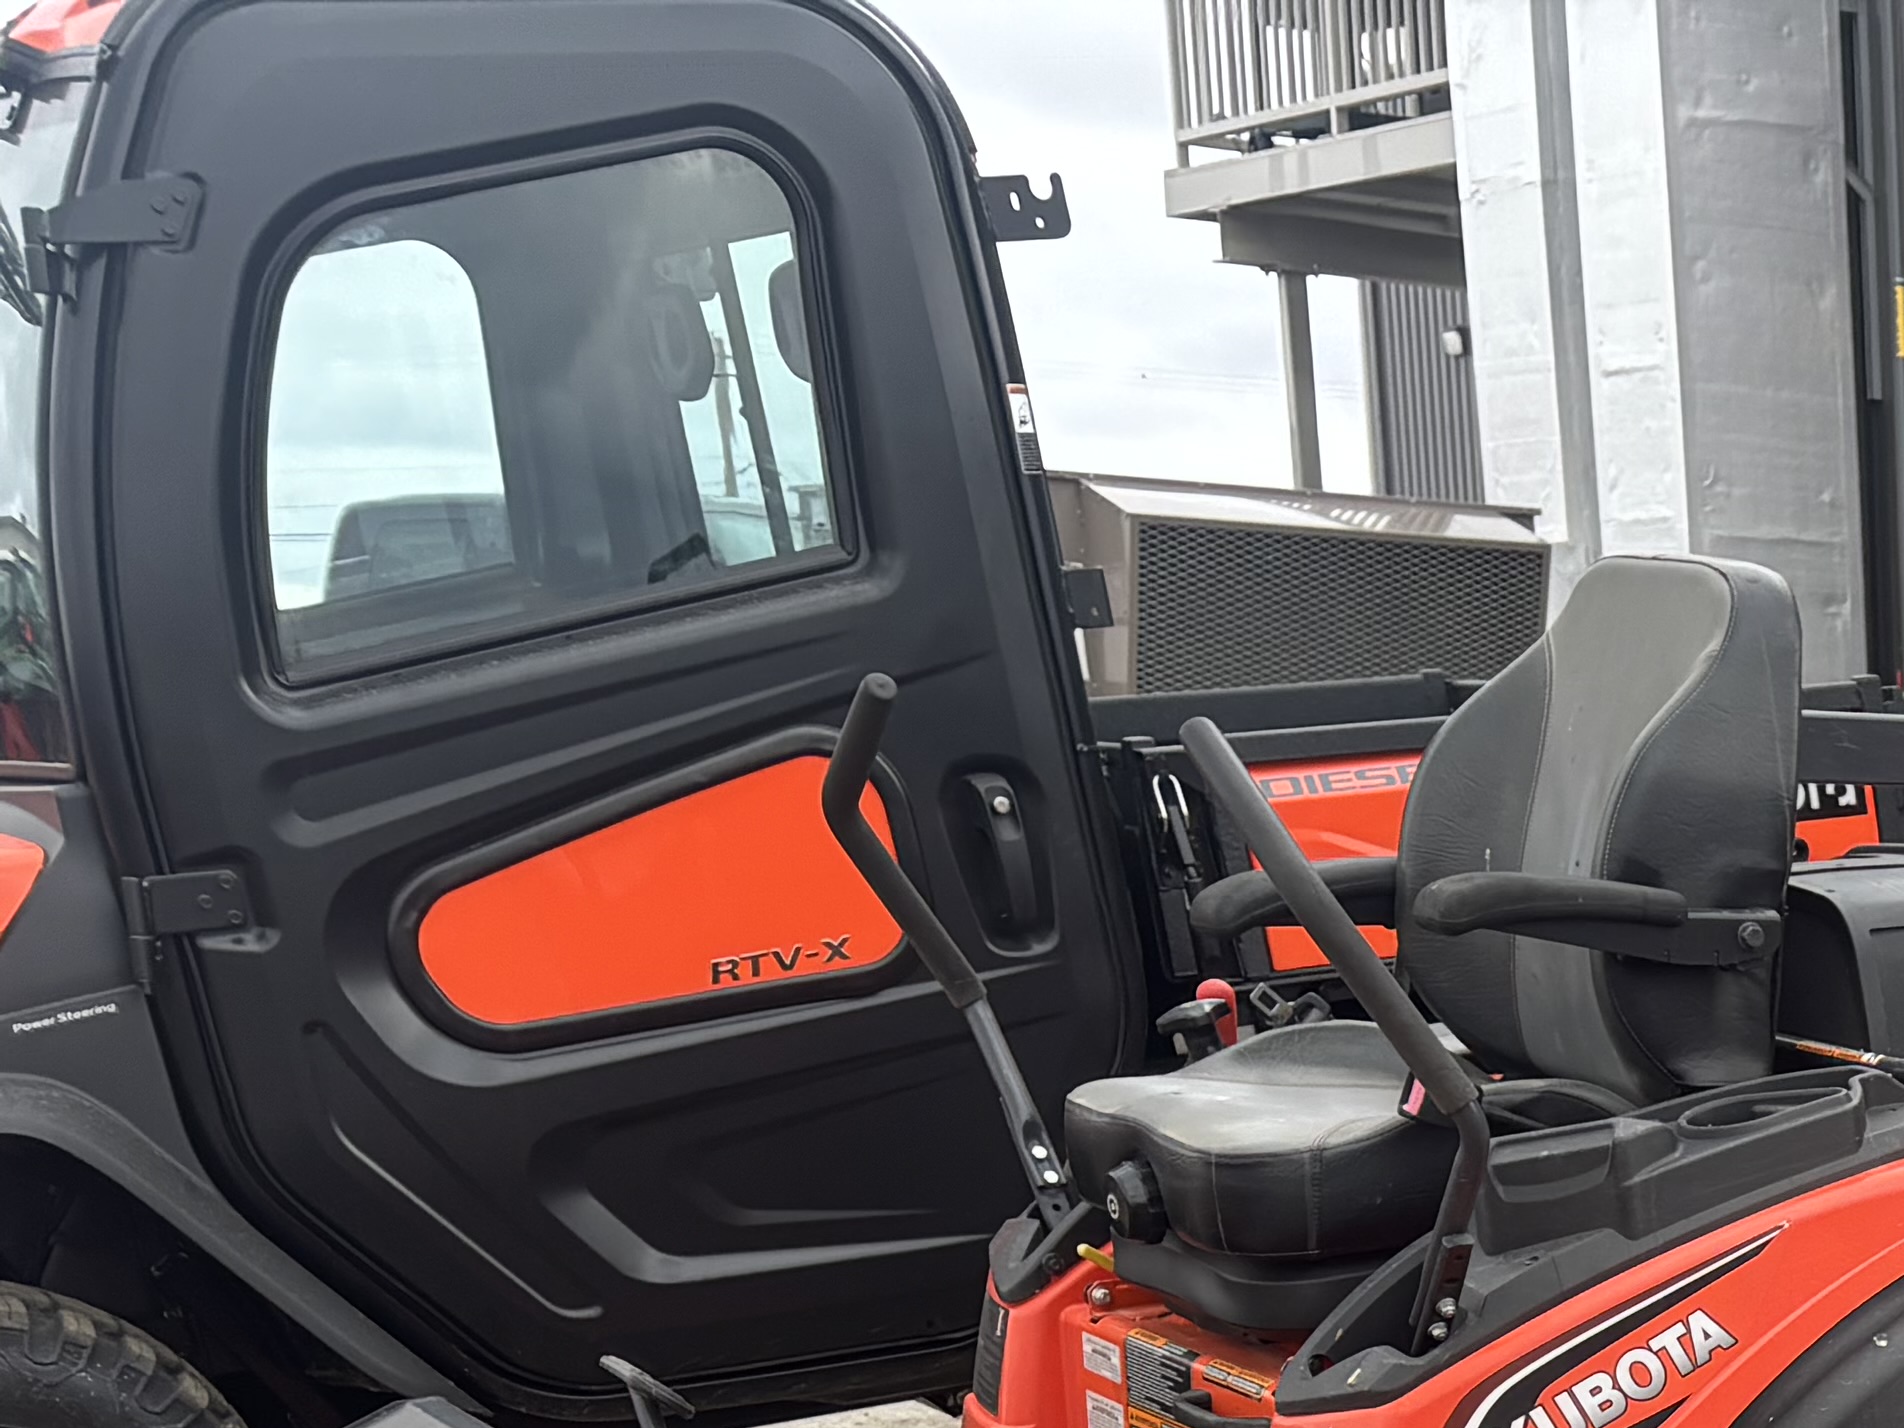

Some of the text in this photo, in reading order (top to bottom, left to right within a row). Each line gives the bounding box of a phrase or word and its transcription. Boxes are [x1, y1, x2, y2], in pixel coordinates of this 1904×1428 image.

[710, 935, 852, 987] RTV-X
[12, 1002, 118, 1033] Power Steering
